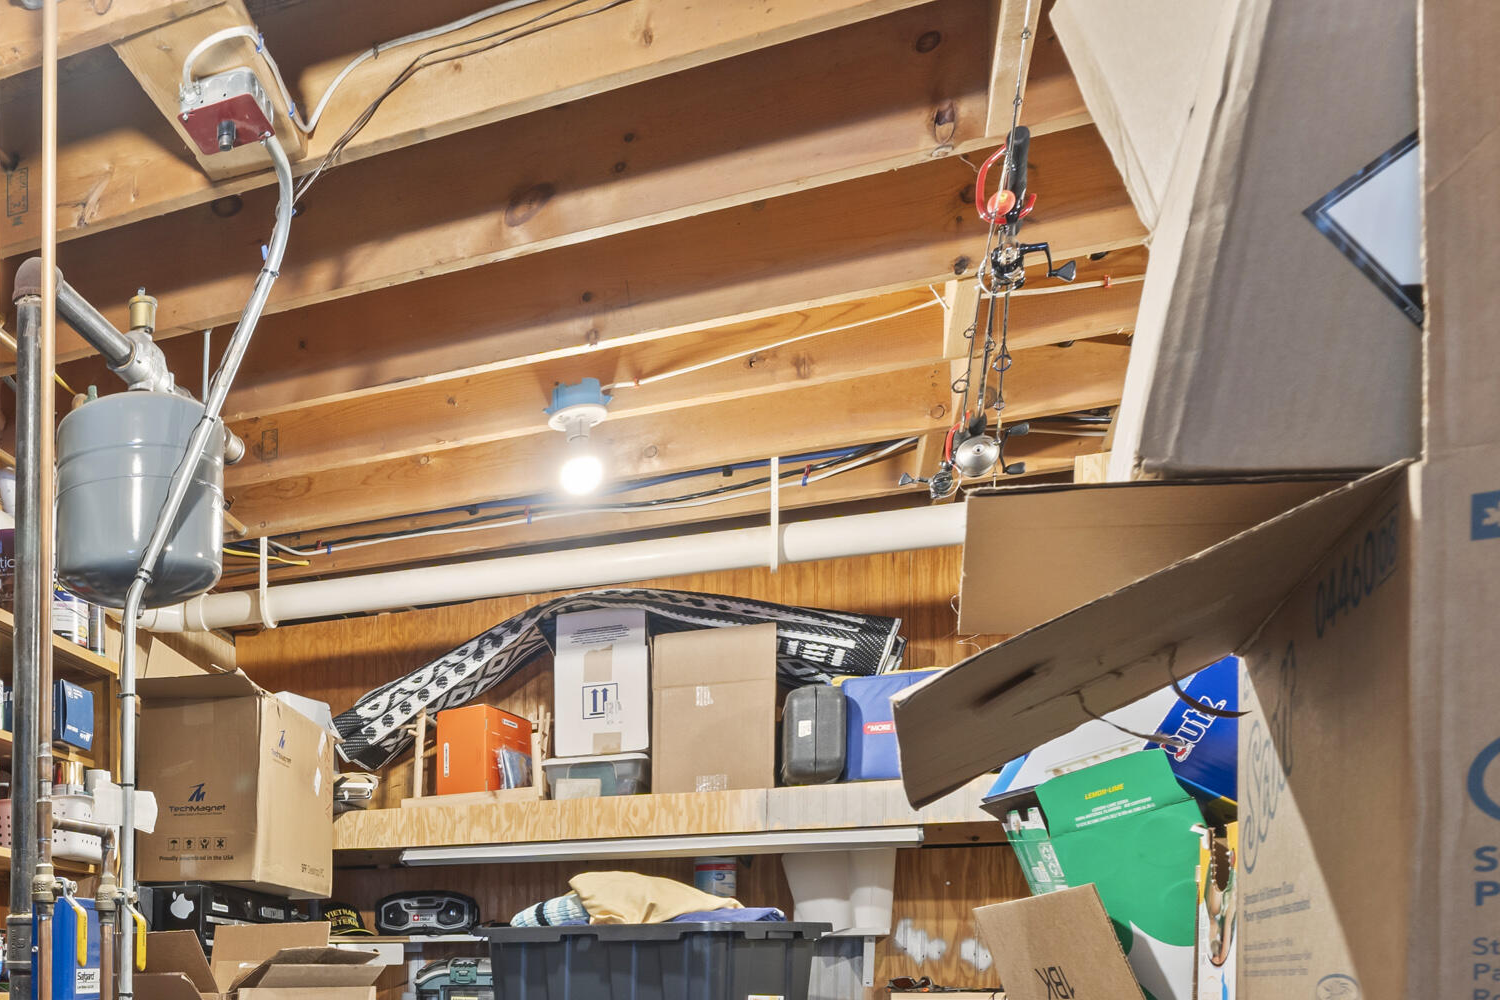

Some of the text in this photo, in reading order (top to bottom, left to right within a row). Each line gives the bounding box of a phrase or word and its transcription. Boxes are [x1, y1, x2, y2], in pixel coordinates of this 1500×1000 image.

[169, 804, 226, 812] TechMagnet
[325, 909, 357, 918] VIETNAM
[331, 917, 360, 928] ETERAN
